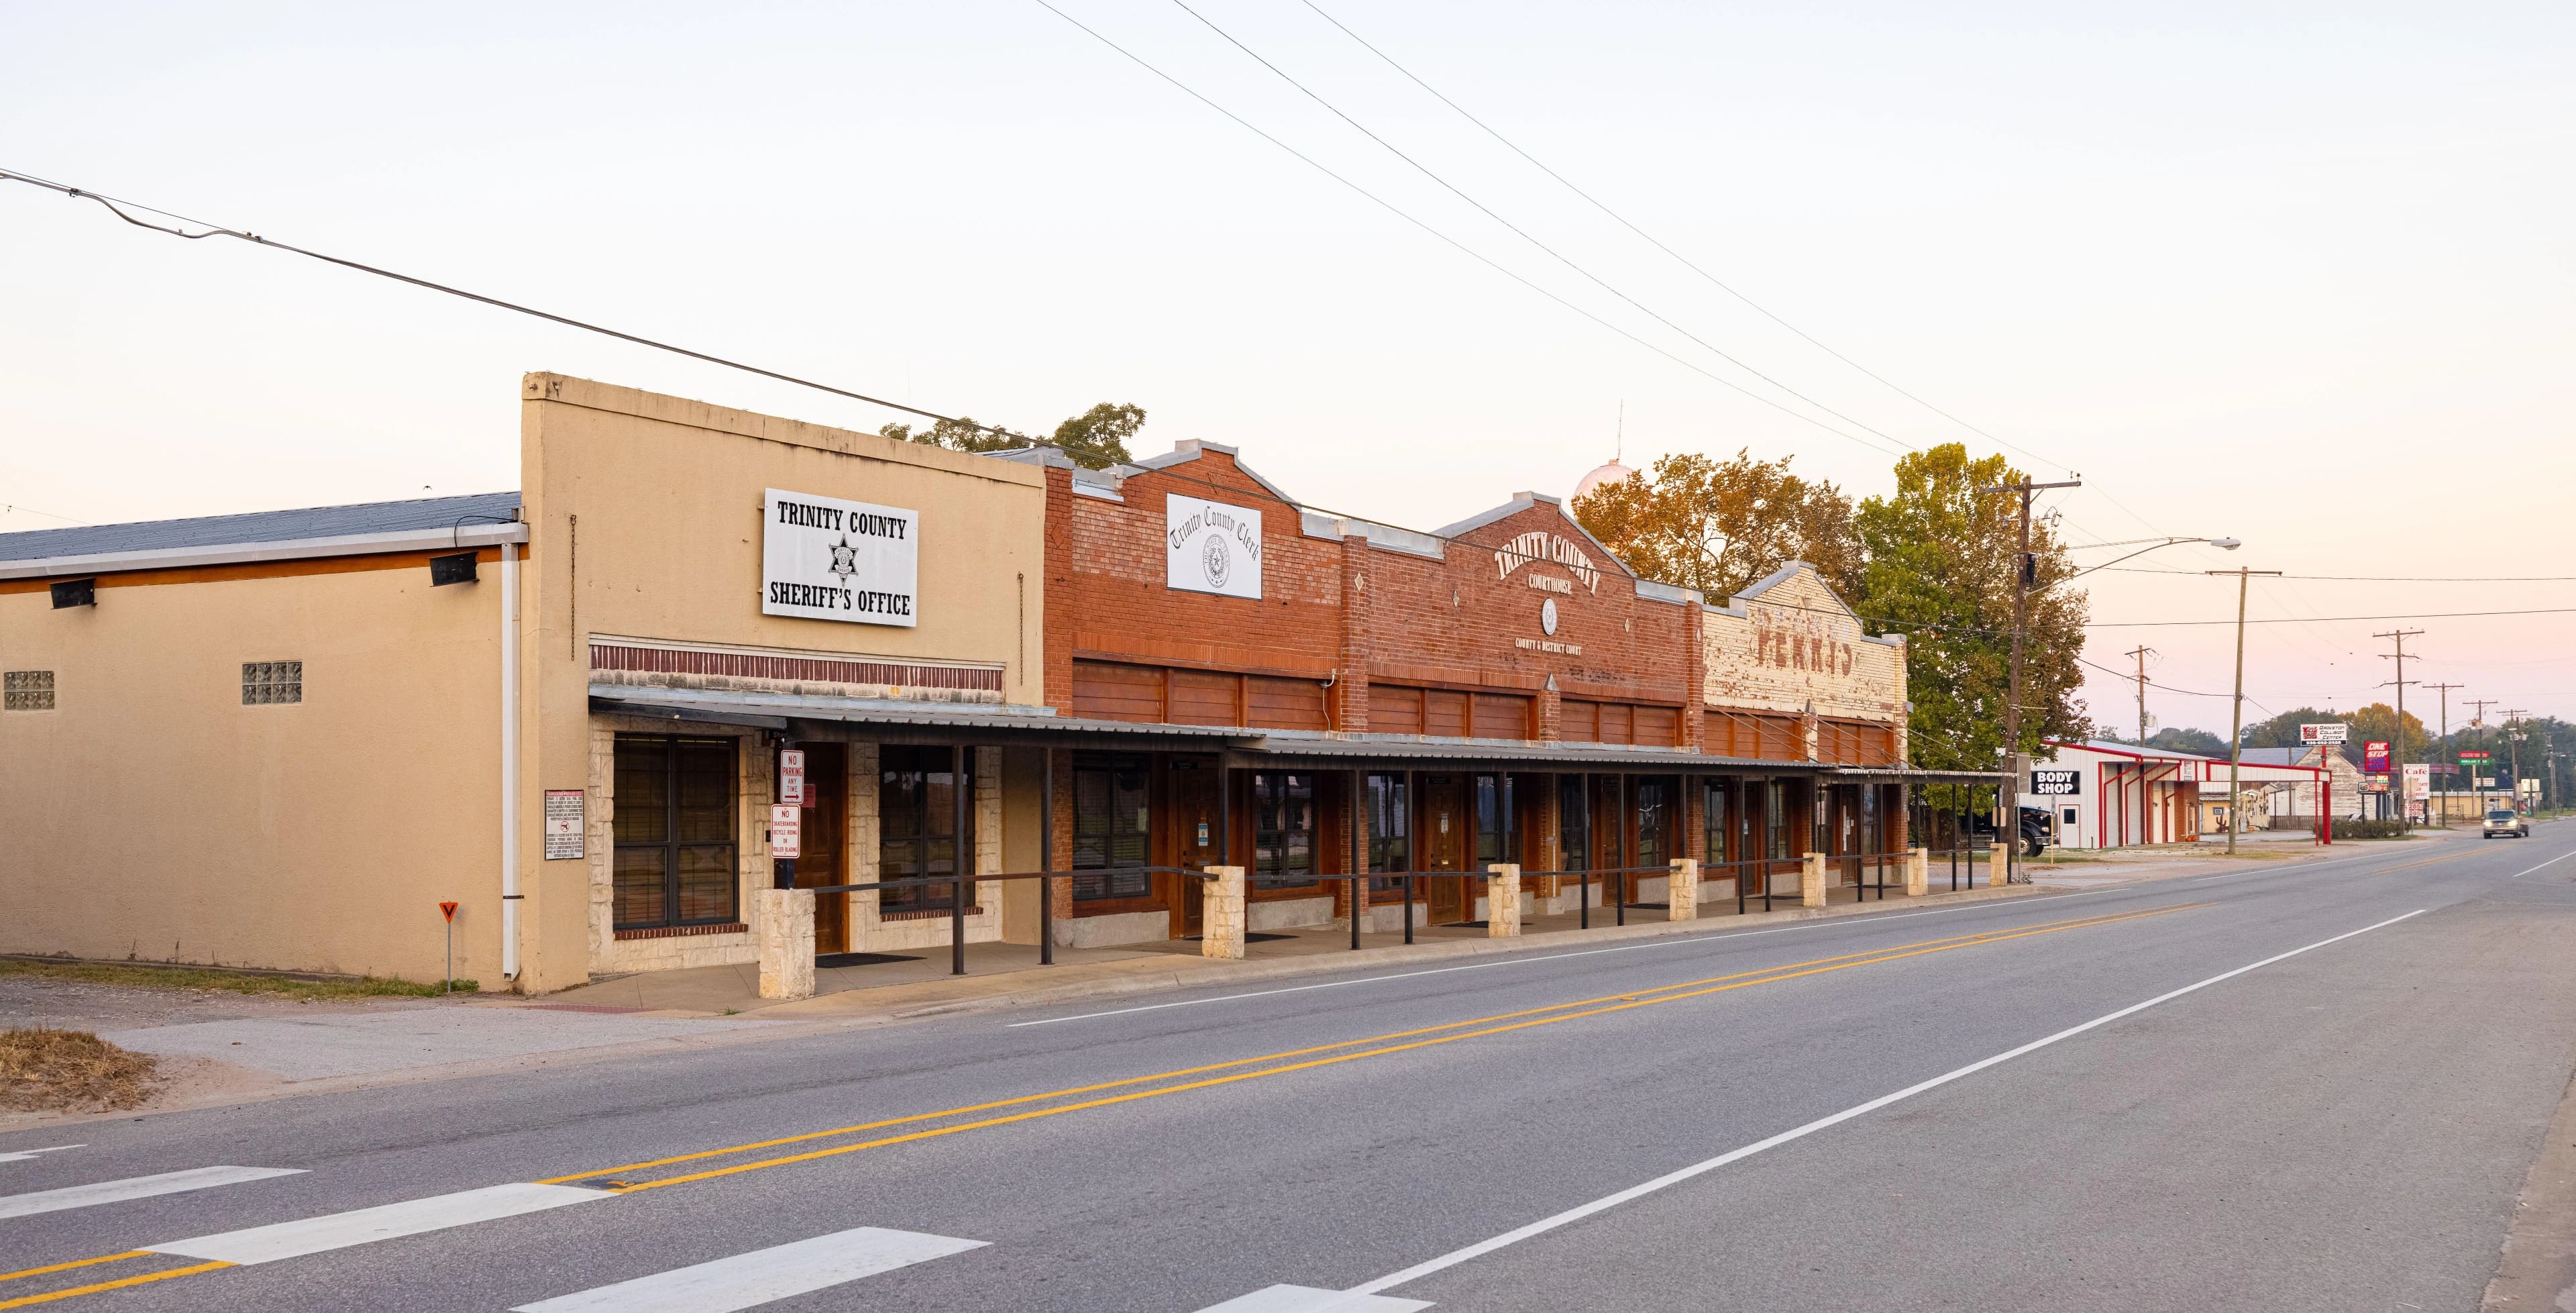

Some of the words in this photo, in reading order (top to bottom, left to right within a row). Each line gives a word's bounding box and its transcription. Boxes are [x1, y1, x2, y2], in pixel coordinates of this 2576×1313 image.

[777, 501, 843, 531] TRINITY
[850, 511, 906, 539] COUNTY
[1170, 511, 1201, 549] Trinity
[1204, 506, 1235, 537] County
[1237, 521, 1259, 562] Clerk
[1495, 531, 1548, 580] TRINITY
[1552, 535, 1601, 596] COUNTY
[1529, 573, 1572, 595] COURTHOUSE
[770, 581, 851, 611] SHERIFF'S
[858, 590, 910, 615] OFFICE
[1515, 637, 1536, 650] COUNTY
[1537, 641, 1541, 650] &
[1542, 641, 1564, 653] DISTRICT
[1566, 645, 1582, 655] COURT
[788, 755, 797, 765] NO
[783, 767, 802, 777] PARKING
[2037, 772, 2074, 782] BODY
[2037, 783, 2074, 794] SHOP
[443, 904, 455, 918] V
